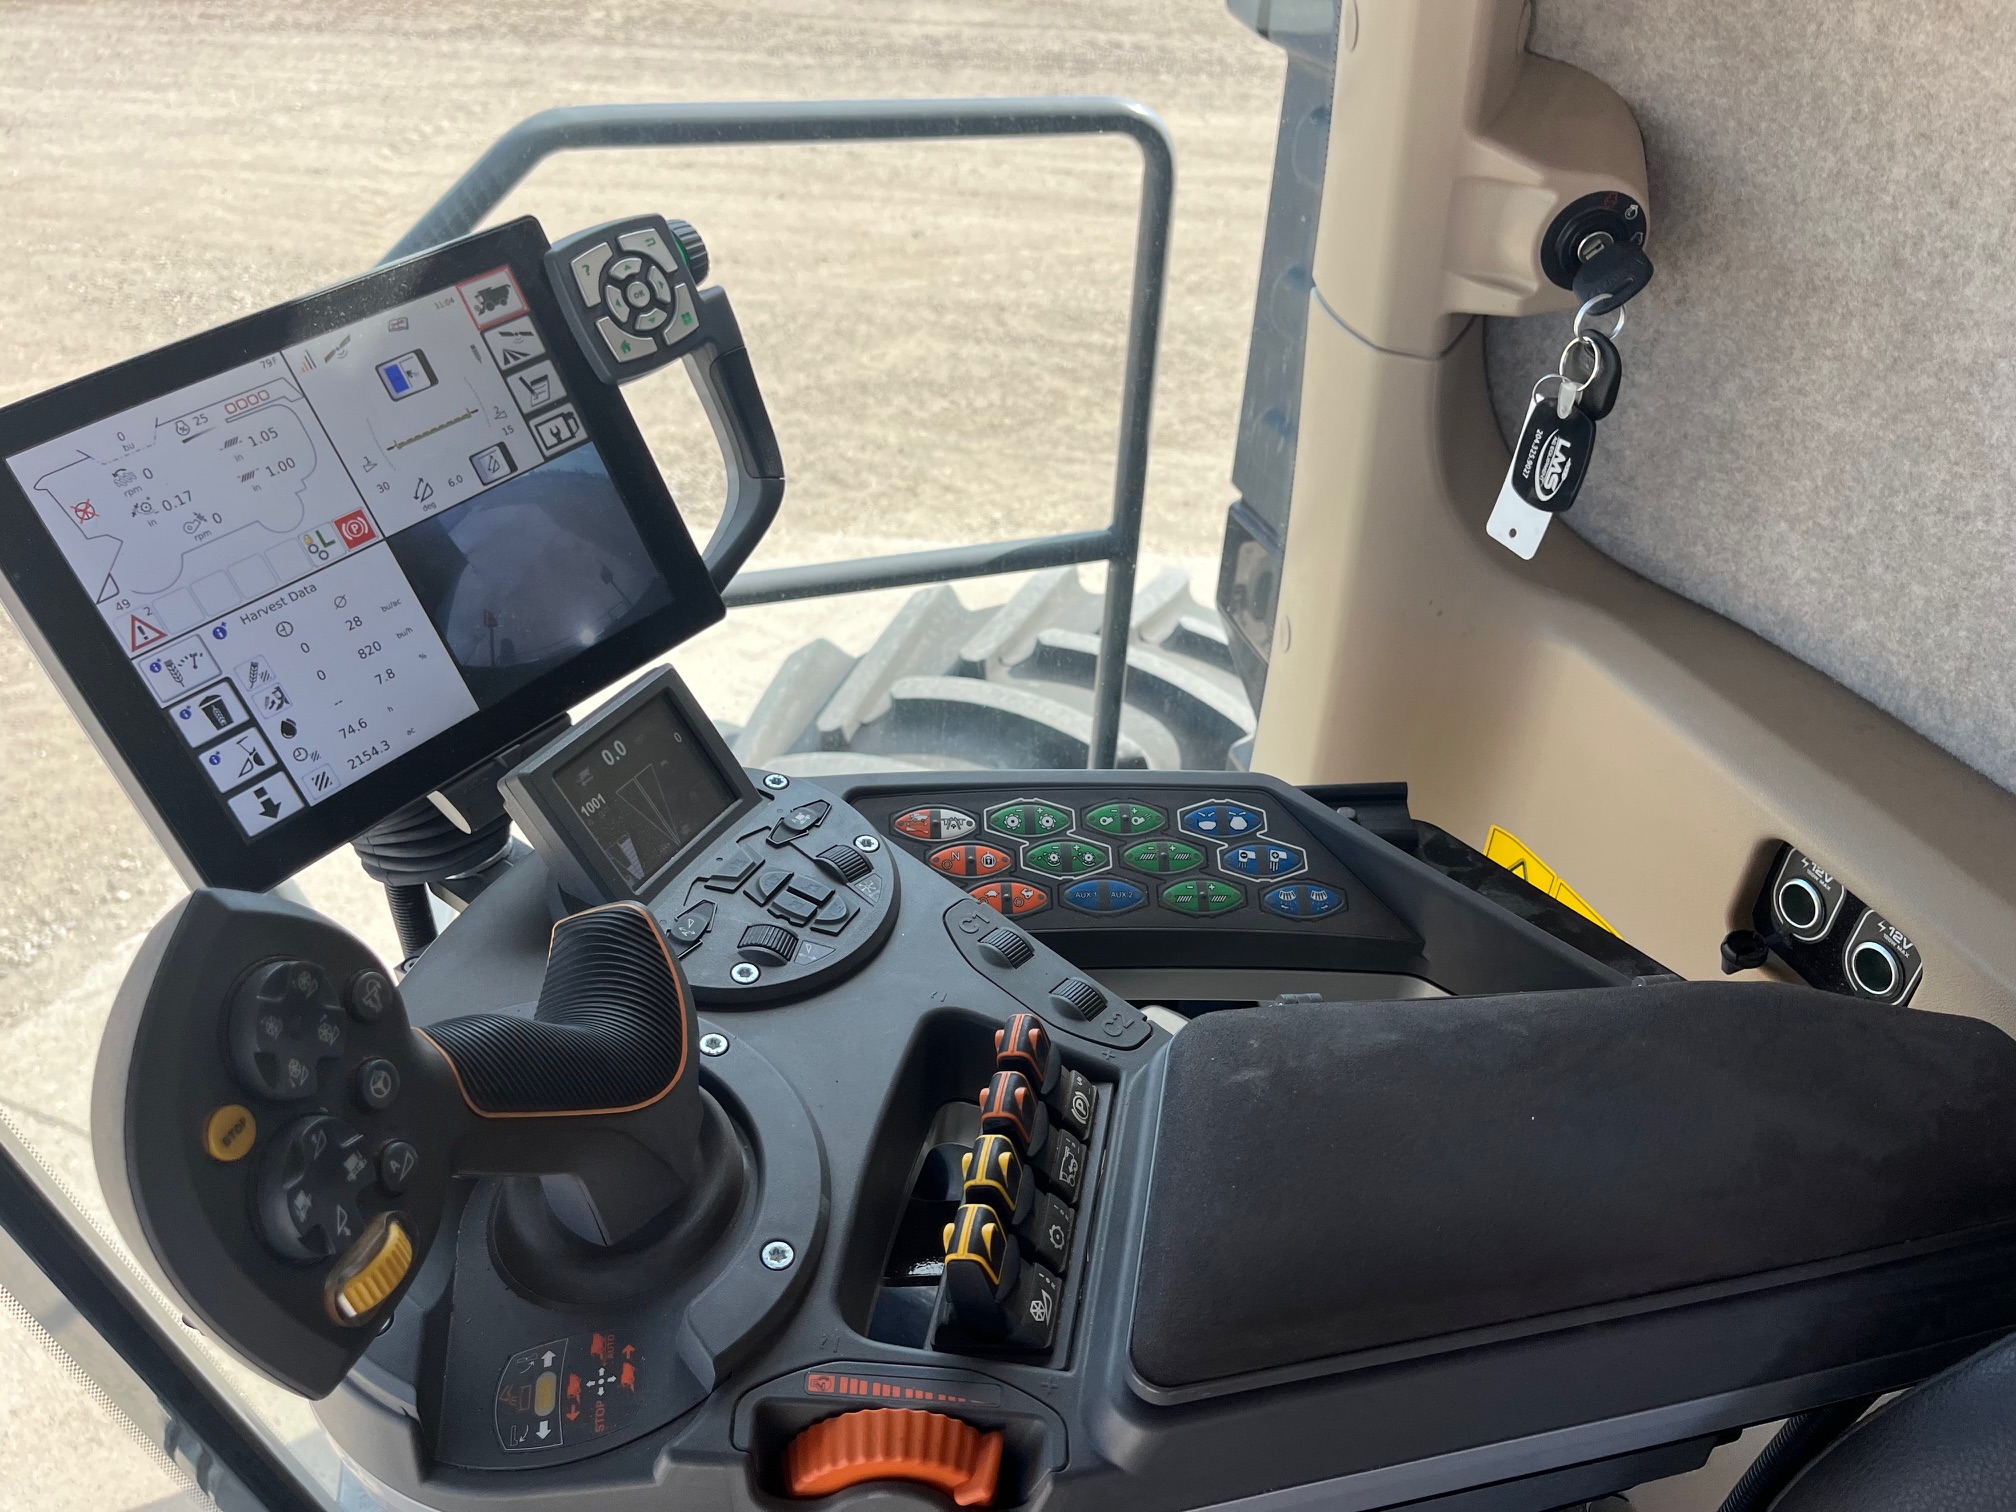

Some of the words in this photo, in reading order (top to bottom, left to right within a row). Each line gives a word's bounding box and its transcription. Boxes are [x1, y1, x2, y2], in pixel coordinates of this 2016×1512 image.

[633, 289, 645, 299] OK
[260, 356, 278, 369] 79F
[192, 413, 208, 426] 25
[117, 431, 126, 441] 0
[248, 427, 278, 447] 1.05
[502, 425, 515, 437] 15
[122, 442, 136, 452] bu
[234, 454, 244, 462] in
[265, 457, 296, 477] 1.00
[142, 468, 154, 480] 0
[376, 481, 391, 494] 30
[447, 474, 464, 488] 6.0
[124, 485, 143, 498] rpm
[252, 484, 262, 492] in
[162, 490, 192, 511] 0.17
[422, 501, 437, 513] deg
[147, 519, 157, 527] in
[212, 512, 222, 524] 0
[194, 529, 212, 542] rpm
[115, 598, 132, 612] 49
[239, 590, 289, 626] Harvest
[289, 583, 318, 604] Data
[142, 606, 153, 617] 2
[345, 616, 364, 631] 28
[380, 597, 403, 613] bu/ac
[300, 642, 310, 654] 0
[357, 640, 383, 660] 820
[395, 626, 414, 639] bu/h
[316, 669, 327, 681] 0
[374, 667, 396, 686] 7.8
[386, 705, 394, 713] h
[338, 717, 368, 740] 74.6
[405, 727, 416, 736] ac
[673, 732, 683, 743] 0
[347, 739, 392, 770] 2154.3
[601, 740, 627, 766] 0.0
[581, 793, 606, 817] 1001
[951, 851, 961, 861] N
[1812, 862, 1834, 884] 12V
[1819, 879, 1831, 891] MAX
[958, 910, 991, 934] C1
[1889, 926, 1914, 950] 12V
[1896, 946, 1910, 959] MAX
[1101, 1013, 1135, 1037] C2
[222, 1116, 247, 1148] STOP
[607, 1334, 615, 1359] AUTO
[595, 1400, 605, 1433] STOP
